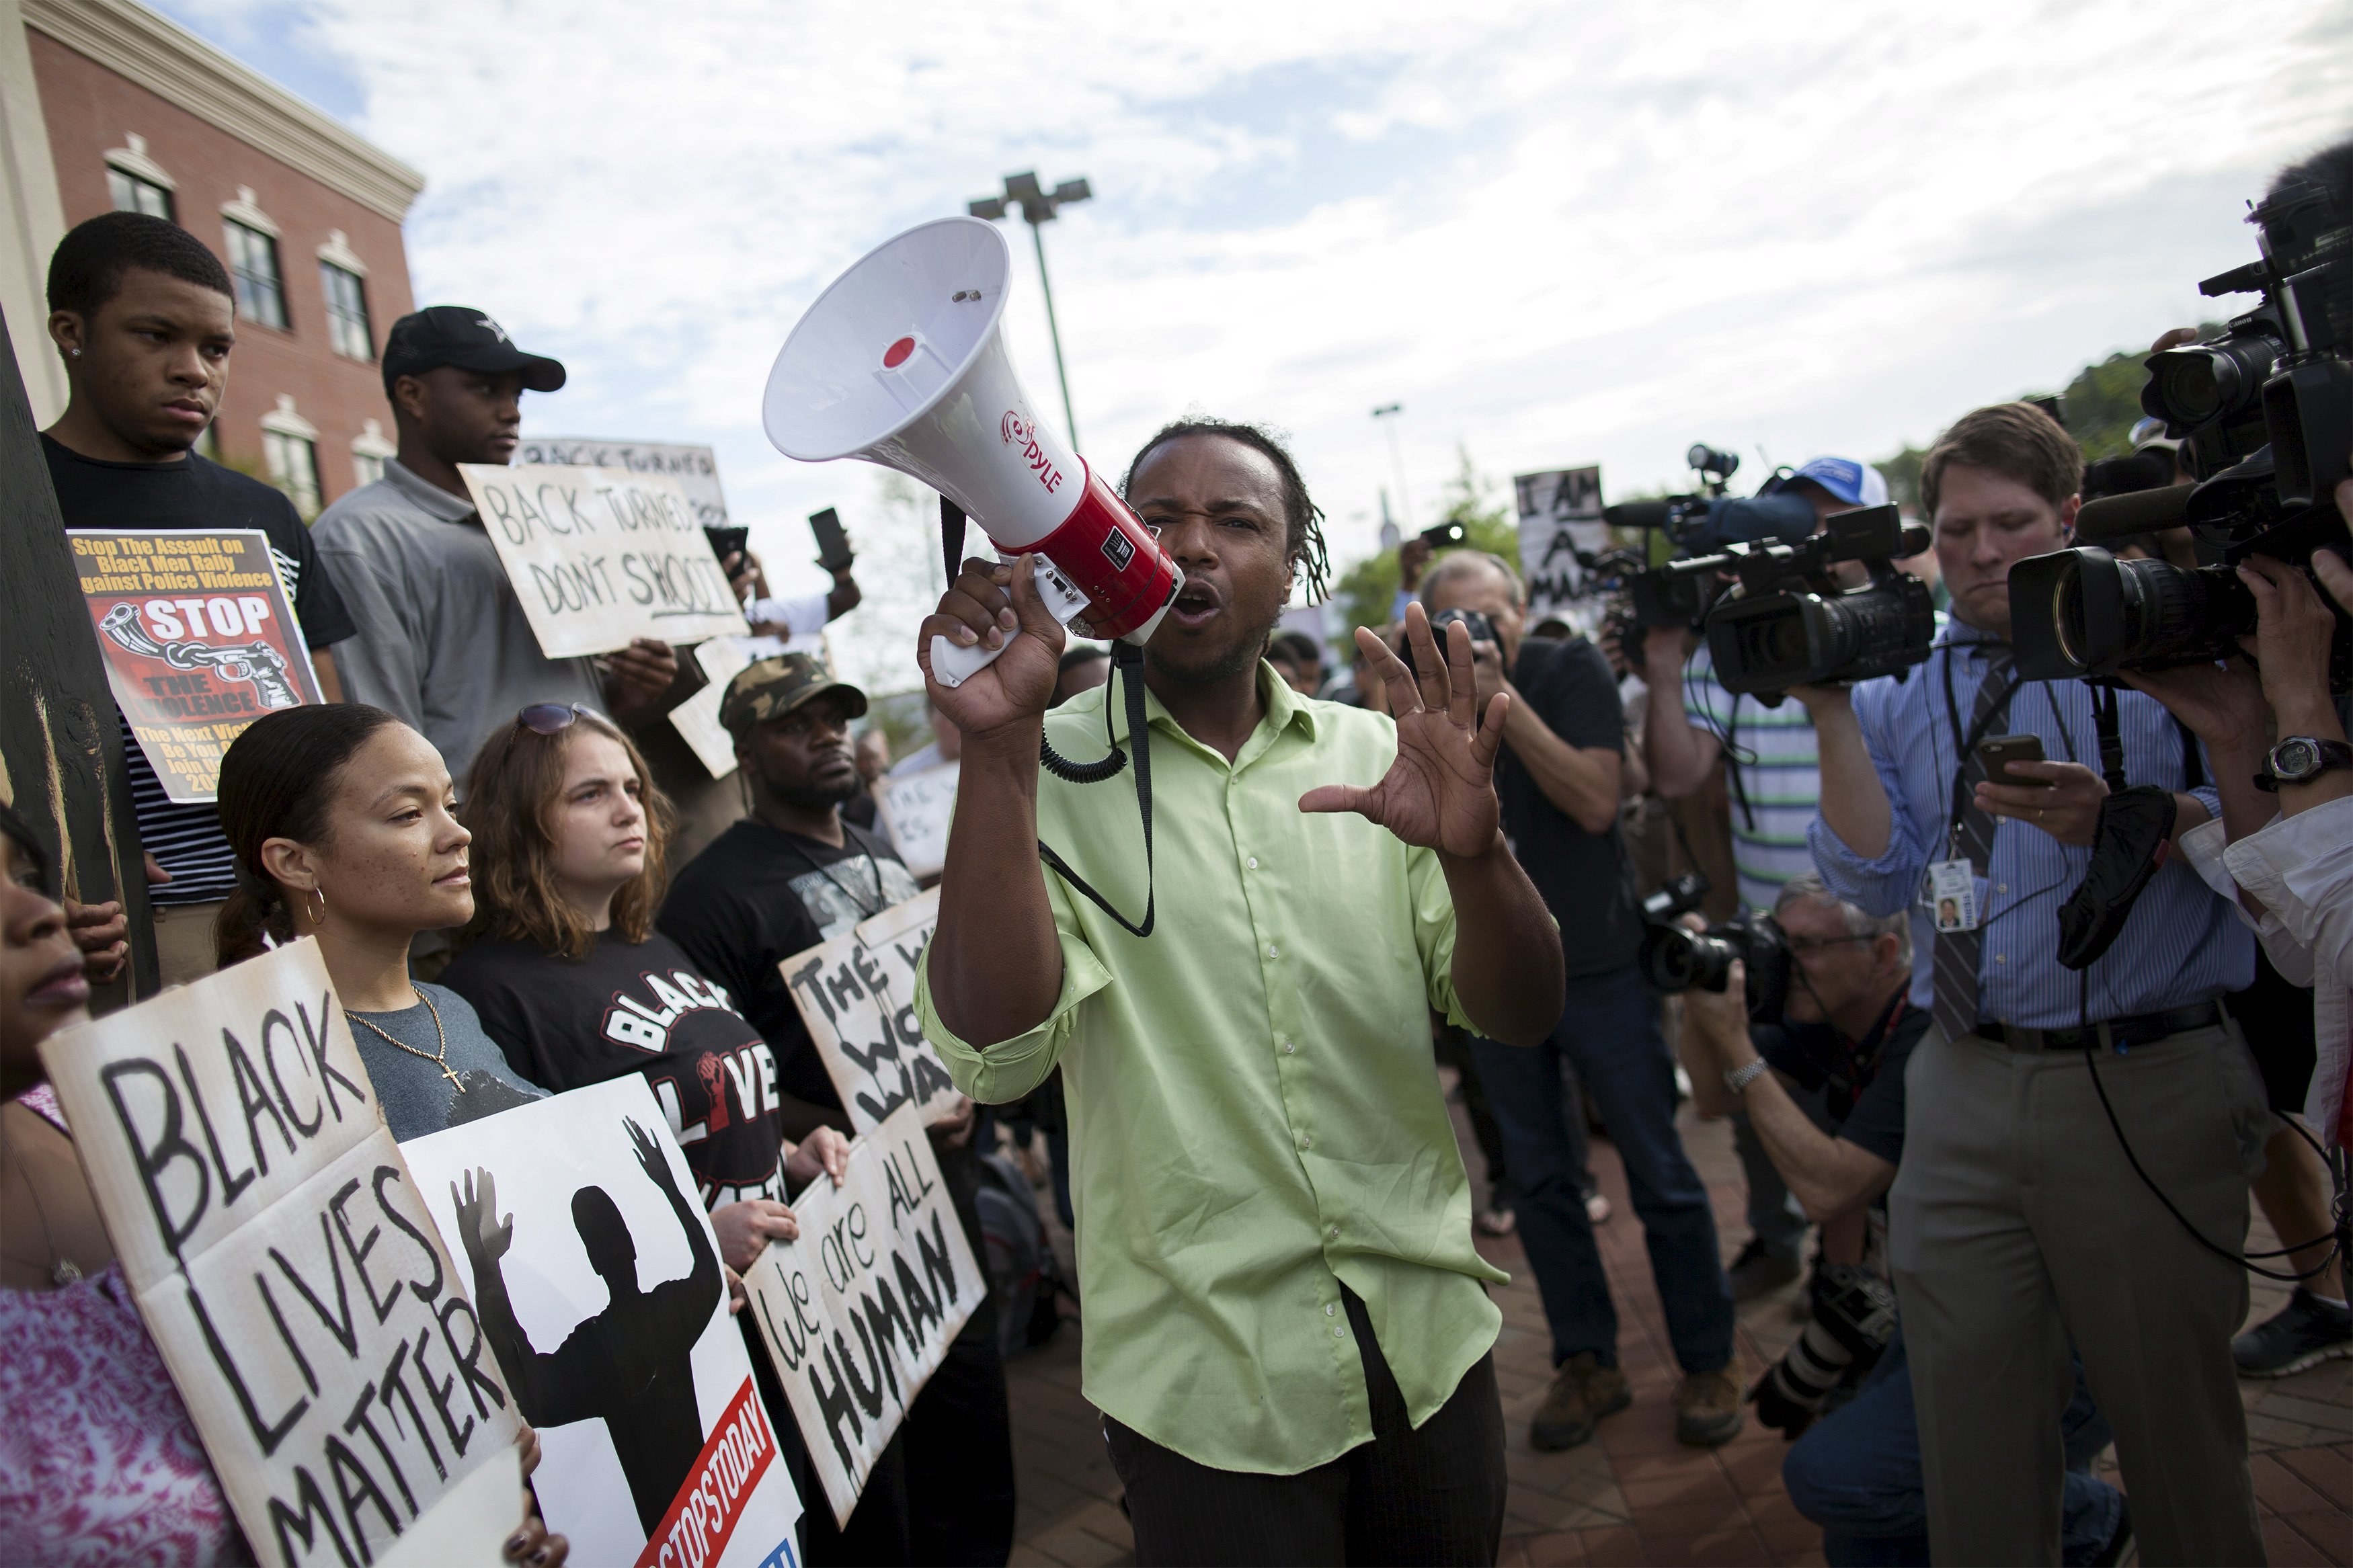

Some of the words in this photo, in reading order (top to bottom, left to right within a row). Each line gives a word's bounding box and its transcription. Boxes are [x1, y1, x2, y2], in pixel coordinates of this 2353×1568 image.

[2229, 317, 2252, 329] Canon
[1023, 440, 1062, 494] PYLE
[484, 482, 596, 544] BACK
[595, 483, 693, 532] TURNED
[71, 538, 118, 556] Stop
[116, 538, 154, 555] The
[154, 537, 223, 555] Assault
[221, 539, 245, 554] on
[95, 555, 152, 573] Black
[151, 556, 192, 573] Men
[190, 554, 235, 573] Rally
[80, 573, 143, 594] gainst
[141, 572, 199, 591] Police
[198, 571, 274, 589] Violence
[529, 552, 618, 615] DON'T
[621, 552, 727, 608] SHOOT
[145, 596, 270, 640] STOP
[134, 692, 256, 718] VIOLENCE
[143, 673, 212, 696] THE
[134, 727, 171, 743] The
[170, 726, 214, 743] Next
[159, 743, 187, 758] Be
[184, 742, 221, 758] You
[166, 758, 204, 774] Join
[606, 970, 745, 1053] BLACK
[791, 944, 889, 1024] THE
[840, 1001, 924, 1073] WO
[856, 1054, 953, 1125] WA
[100, 988, 366, 1255] BLACK
[758, 1262, 820, 1372] We
[822, 1202, 875, 1293] are
[883, 1140, 934, 1231] ALL
[188, 1165, 445, 1458] LIVES
[808, 1208, 959, 1489] HUMAN
[266, 1296, 506, 1568] MATTER
